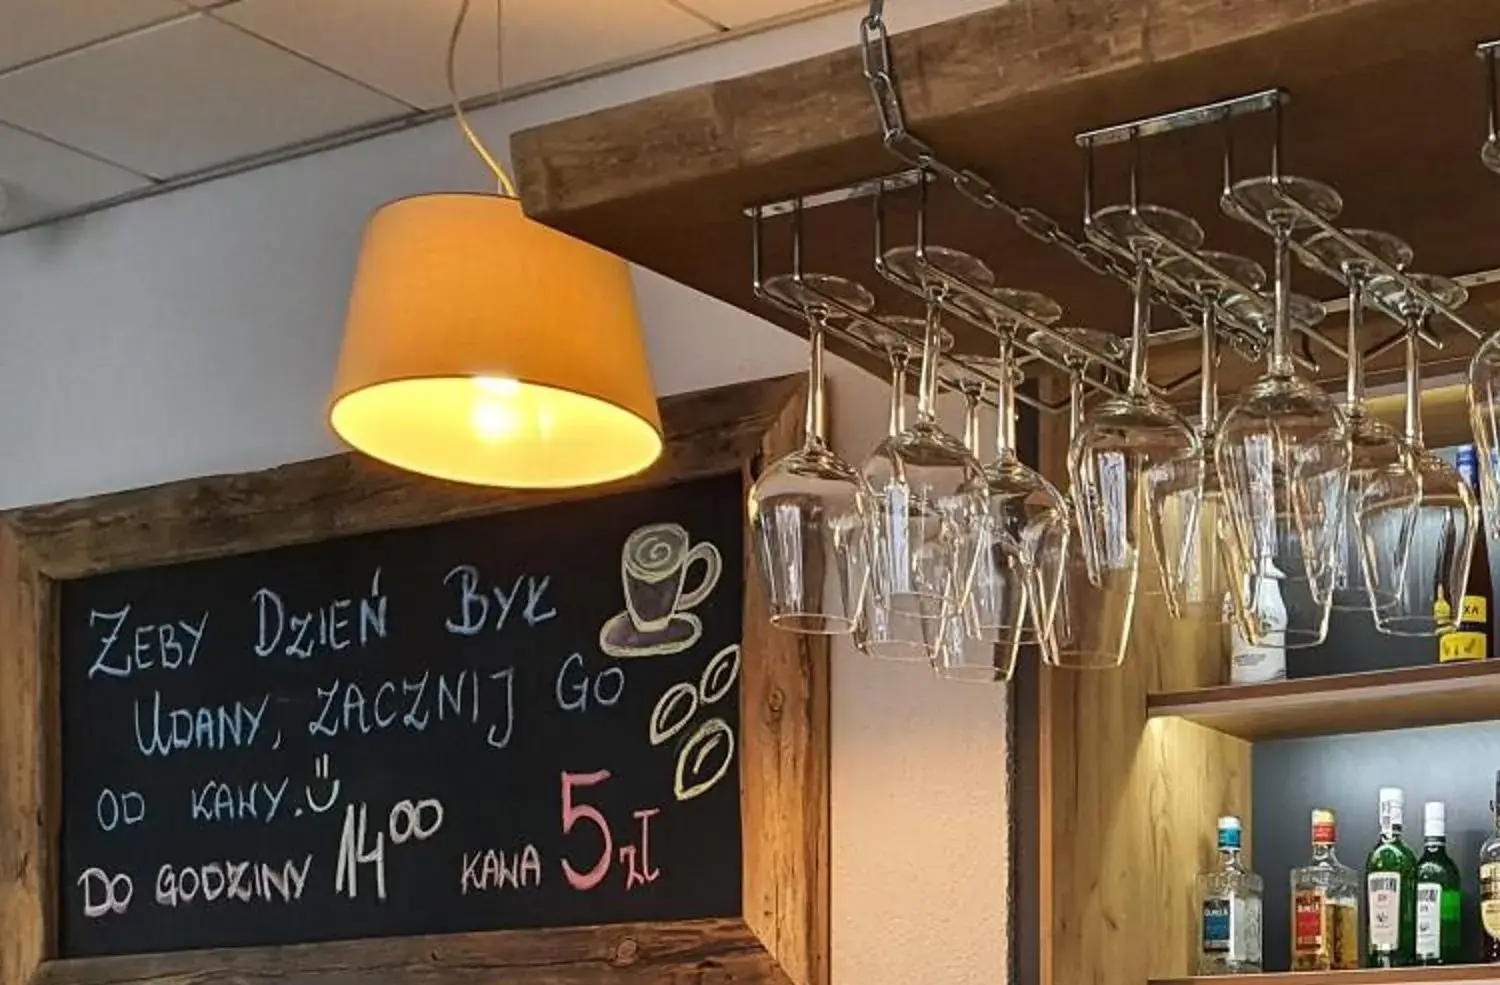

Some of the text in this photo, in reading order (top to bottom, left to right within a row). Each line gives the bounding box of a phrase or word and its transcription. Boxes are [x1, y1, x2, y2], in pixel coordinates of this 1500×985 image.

[308, 669, 515, 748] ZACZNIJ
[556, 652, 625, 712] GO
[97, 788, 145, 831] OD
[561, 769, 612, 892] 5
[77, 867, 133, 917] DO
[155, 854, 312, 908] GODZINY
